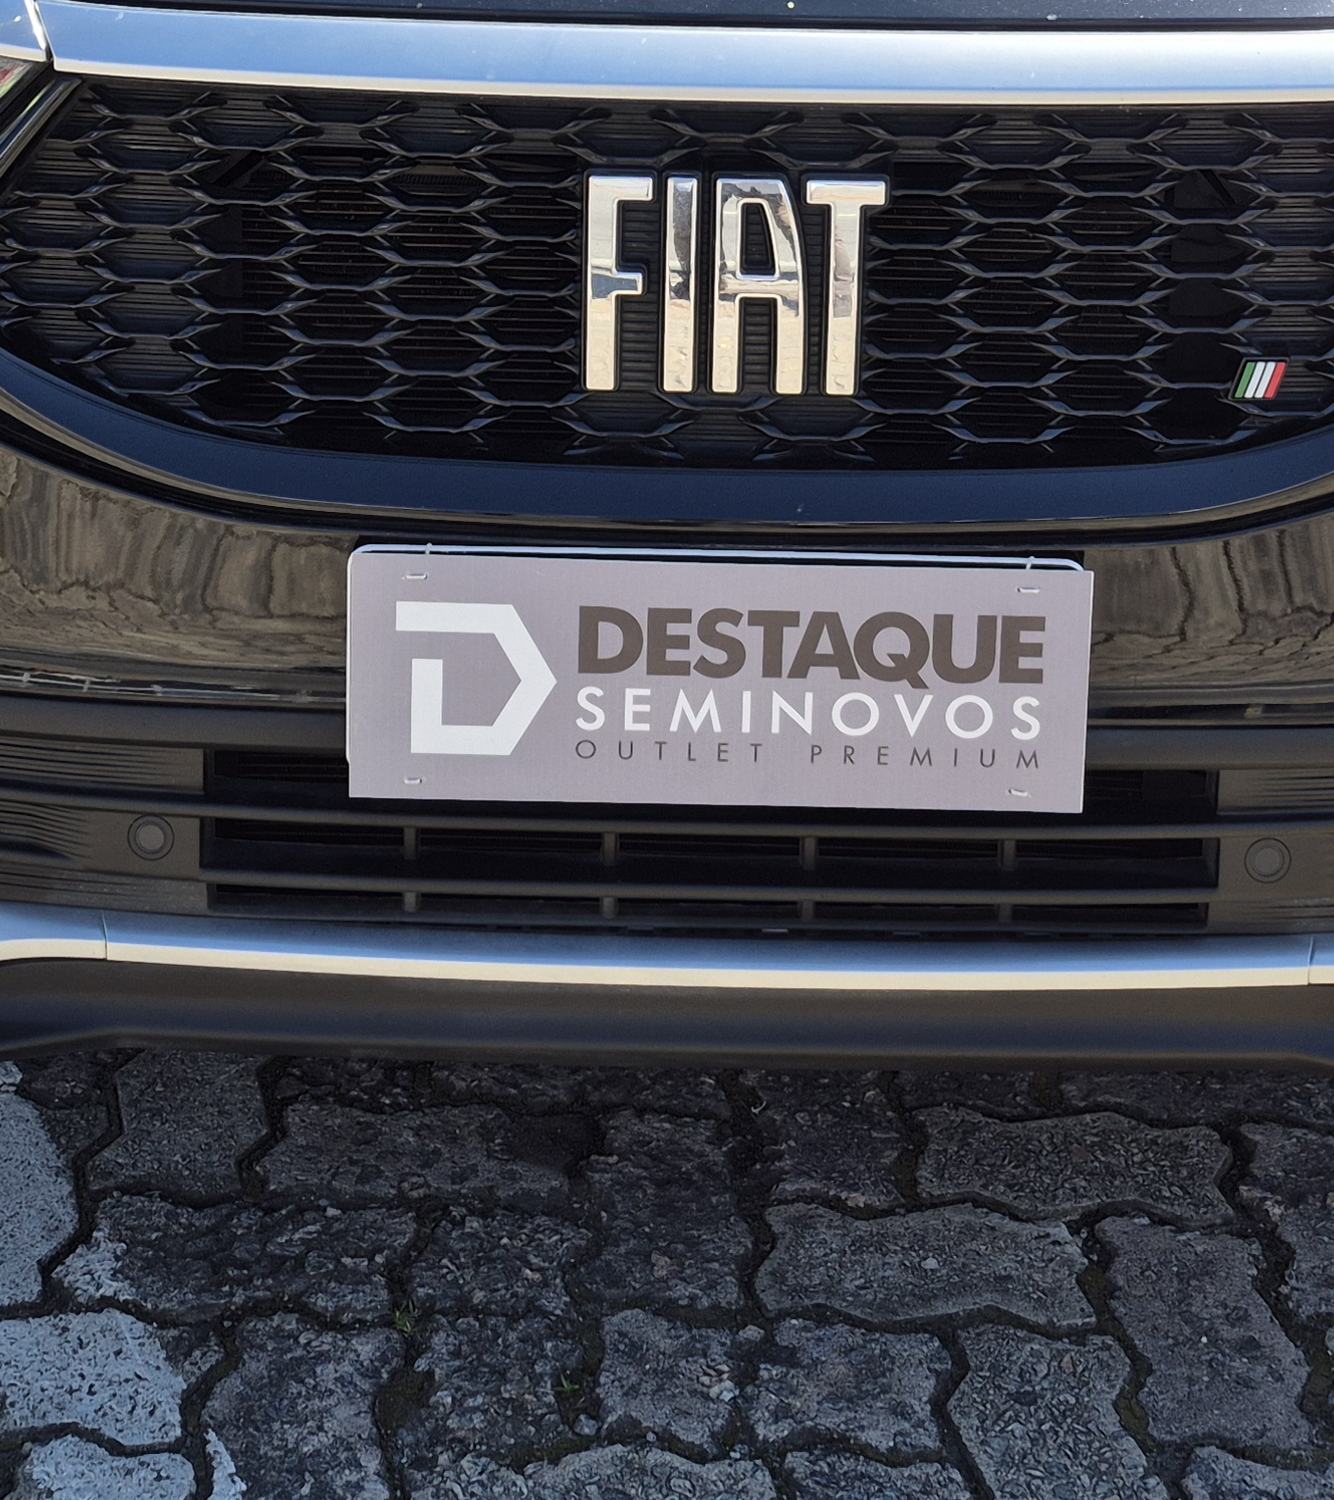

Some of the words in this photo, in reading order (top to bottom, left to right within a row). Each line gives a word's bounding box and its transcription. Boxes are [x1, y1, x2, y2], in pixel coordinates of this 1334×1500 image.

[582, 174, 890, 398] FIAT
[577, 605, 1046, 690] DESTAQUE
[576, 685, 1042, 741] SEMINOVOS
[576, 739, 764, 765] OUTLET
[811, 741, 1041, 770] PREMIUM
